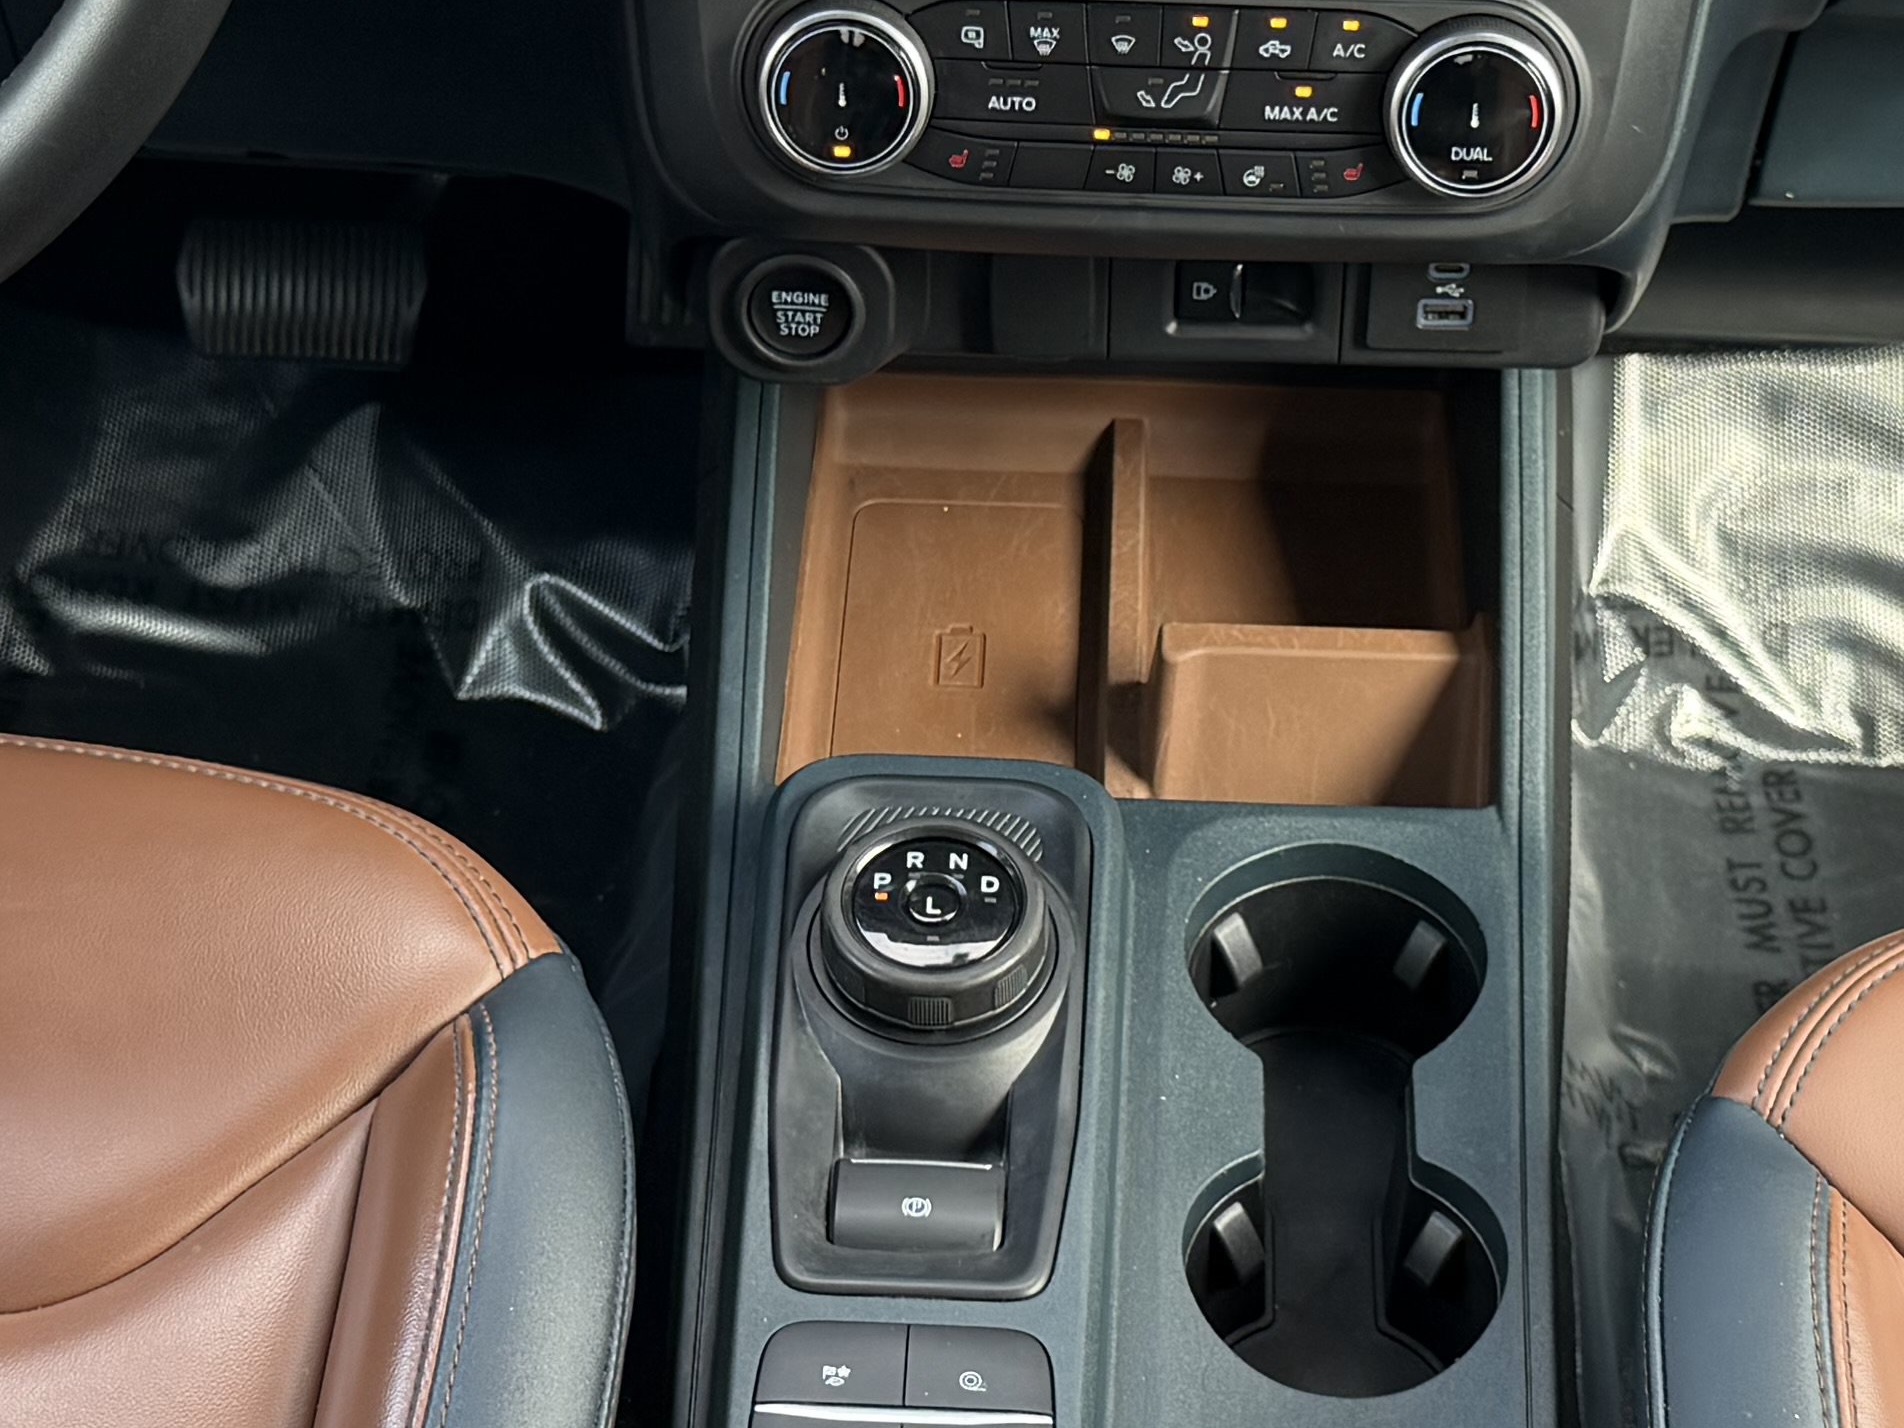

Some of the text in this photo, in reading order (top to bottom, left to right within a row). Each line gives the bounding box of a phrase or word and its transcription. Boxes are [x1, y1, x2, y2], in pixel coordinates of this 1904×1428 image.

[1030, 27, 1060, 40] MAX
[1333, 43, 1366, 59] A/C
[988, 97, 1036, 112] AUTO
[1264, 106, 1339, 123] MAX A/C
[1450, 145, 1493, 162] DUAL
[771, 290, 830, 307] ENGINE
[776, 311, 825, 325] START
[779, 322, 821, 338] STOP
[1761, 769, 1819, 882] COVER
[873, 851, 1000, 893] P R N D
[926, 896, 942, 915] L
[1726, 857, 1783, 954] MUST
